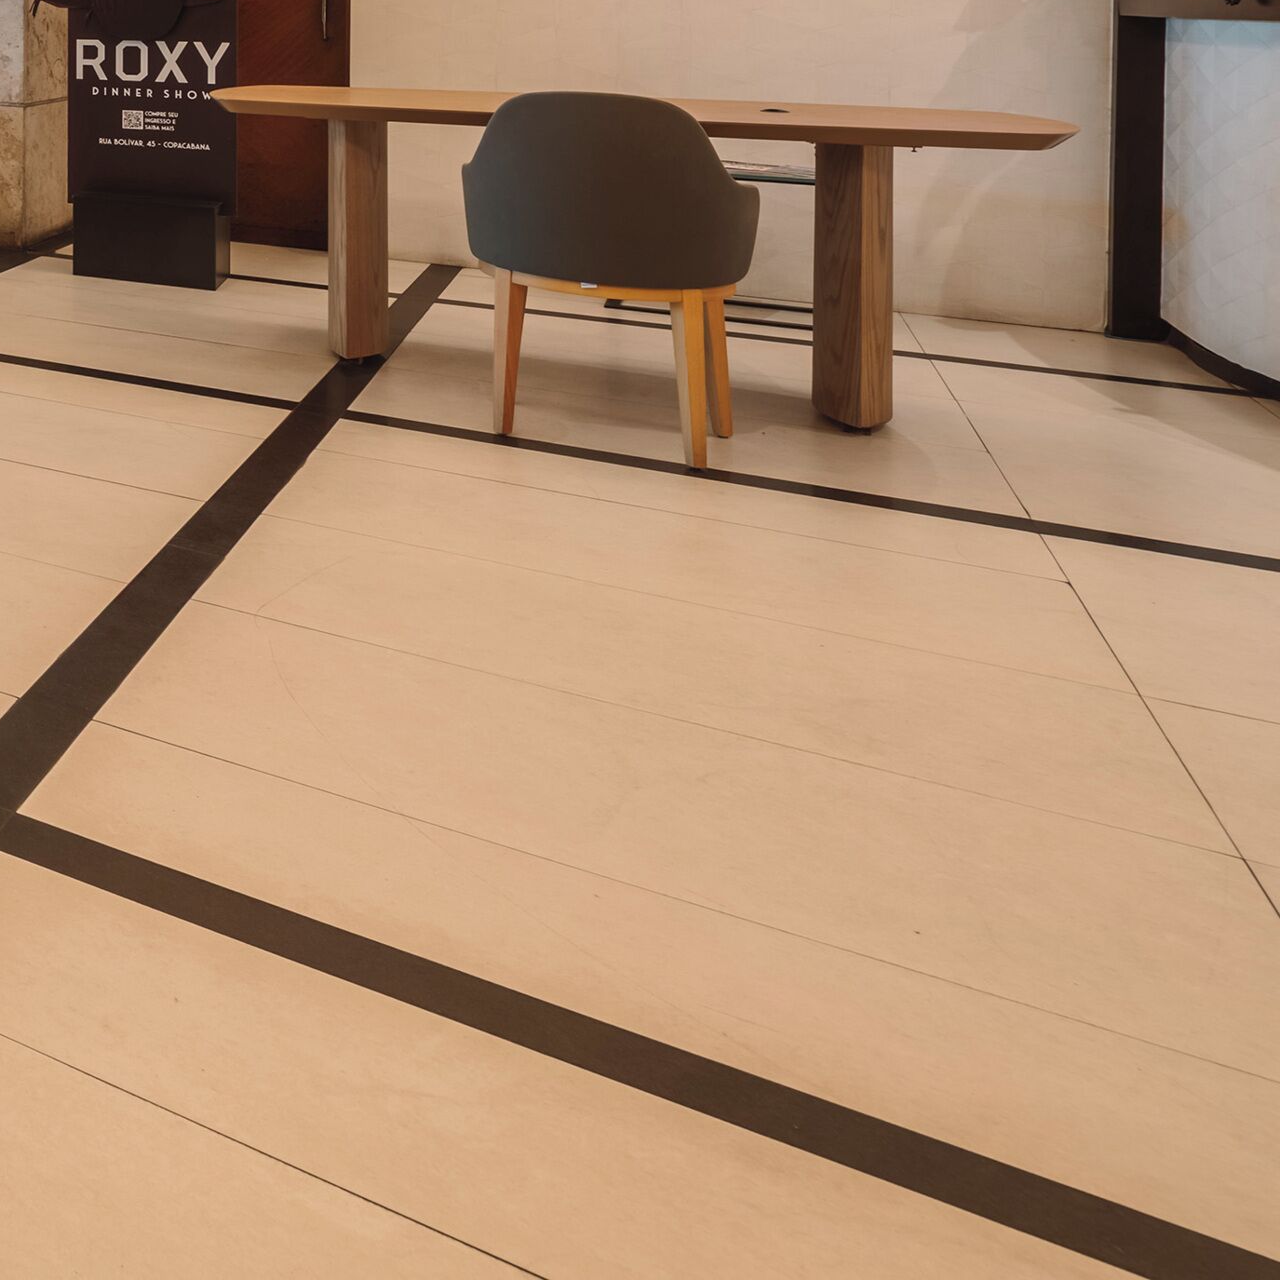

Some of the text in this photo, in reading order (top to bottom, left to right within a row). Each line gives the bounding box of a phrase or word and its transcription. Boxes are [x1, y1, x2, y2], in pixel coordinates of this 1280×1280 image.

[76, 39, 230, 84] ROXY
[92, 87, 153, 98] DINNER
[144, 110, 167, 118] COMPRE
[163, 141, 211, 150] COPACABANA
